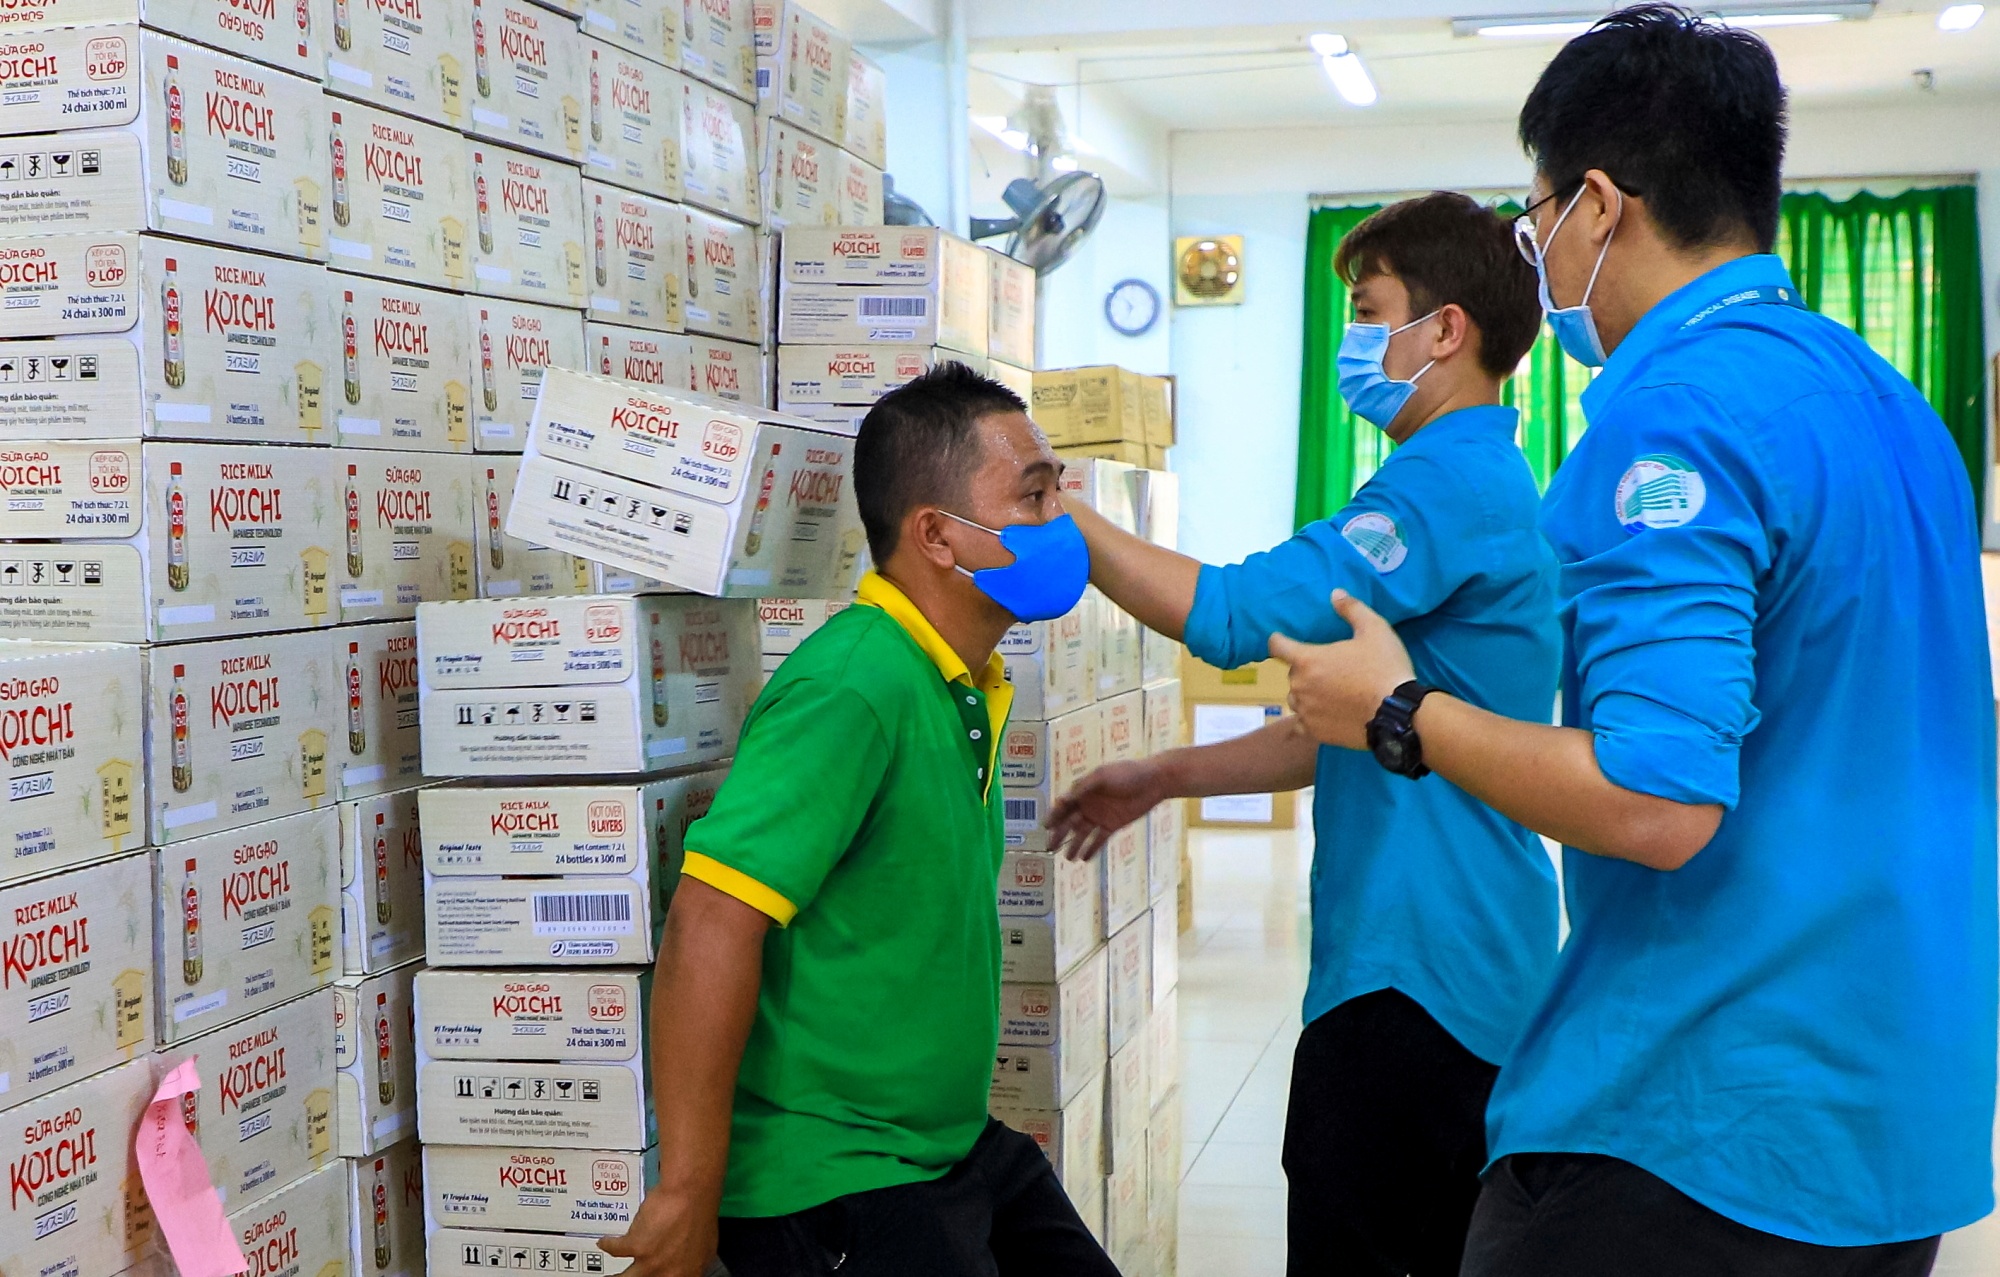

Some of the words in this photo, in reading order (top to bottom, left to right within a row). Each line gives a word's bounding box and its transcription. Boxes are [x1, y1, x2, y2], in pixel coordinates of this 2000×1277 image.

[219, 11, 241, 31] GẠO
[505, 8, 522, 25] RICE
[522, 15, 538, 31] MILK
[20, 43, 44, 54] GẠO
[107, 40, 120, 50] CAO
[500, 25, 546, 66] KOICHI
[0, 56, 57, 86] OICHI
[89, 63, 96, 75] 9
[100, 60, 124, 75] LỚP
[215, 70, 238, 92] RICE
[240, 77, 266, 98] MILK
[62, 103, 73, 113] 24
[75, 101, 91, 113] chai
[94, 103, 98, 111] x
[100, 100, 116, 111] 300
[118, 98, 127, 110] ml
[612, 77, 651, 114] KOICHI
[206, 92, 275, 141] KOICHI
[372, 124, 393, 142] RICE
[393, 131, 414, 147] MILK
[364, 142, 423, 185] KOICHI
[507, 161, 524, 176] RICE
[525, 166, 541, 180] MILK
[502, 178, 549, 215] KOICHI
[616, 217, 654, 250] KOICHI
[0, 248, 20, 258] SỮA
[21, 248, 45, 259] GẠO
[704, 237, 736, 267] KOICHI
[833, 242, 880, 256] KOICHI
[907, 247, 926, 256] LAYERS
[0, 262, 58, 288] OICHI
[88, 271, 96, 282] 9
[100, 267, 124, 282] LỚP
[215, 266, 239, 283] RICE
[241, 271, 266, 287] MILK
[205, 288, 275, 334] KOICHI
[382, 298, 400, 313] RICE
[401, 300, 421, 316] MILK
[527, 317, 542, 331] GẠO
[374, 317, 428, 357] KOICHI
[506, 334, 551, 369] KOICHI
[624, 357, 664, 385] KOICHI
[705, 363, 740, 392] KOICHI
[828, 361, 875, 376] KOICHI
[628, 397, 651, 409] SỮA
[651, 402, 672, 416] GẠO
[611, 407, 679, 440] KOICHI
[1, 451, 25, 462] SỮA
[25, 451, 49, 463] GẠO
[703, 441, 712, 452] 9
[714, 439, 737, 458] LỚP
[92, 476, 100, 488] 9
[103, 473, 128, 488] LỚP
[221, 463, 246, 479] RICE
[247, 464, 273, 479] MILK
[386, 466, 403, 483] SỮA
[404, 469, 421, 485] GẠO
[788, 468, 843, 507] KOICHI
[66, 514, 77, 524] 24
[78, 513, 94, 524] chai
[101, 513, 117, 523] 300
[119, 513, 129, 523] ml
[210, 486, 282, 532] KOICHI
[377, 488, 431, 529] KOICHI
[525, 608, 547, 618] GẠO
[492, 621, 561, 645] KOICHI
[586, 629, 595, 640] 9
[597, 626, 620, 640] LỚP
[221, 657, 246, 675] RICE
[247, 654, 271, 671] MILK
[1, 678, 28, 701] SỮA
[30, 676, 59, 698] GẠO
[211, 677, 280, 729] KOICHI
[13, 755, 28, 768] CÔNG
[29, 752, 45, 769] NGHỆ
[12, 777, 52, 796] ライスミルク
[501, 801, 524, 810] RICE
[526, 801, 550, 809] MILK
[591, 807, 604, 818] NOT
[605, 807, 622, 818] OVER
[491, 812, 559, 836] KOICHI
[591, 821, 596, 833] 9
[597, 820, 623, 833] LAYERS
[234, 844, 255, 865] SỮA
[256, 840, 278, 860] GẠO
[439, 843, 466, 853] Original
[467, 844, 482, 852] Taste
[555, 855, 566, 864] 24
[566, 854, 593, 864] bottles
[600, 854, 615, 864] 300
[616, 854, 626, 863] ml
[1018, 874, 1023, 882] 9
[1026, 873, 1042, 882] LỚP
[222, 860, 290, 920] KOICHI
[15, 900, 45, 926] RICE
[46, 892, 79, 917] MILK
[3, 917, 90, 990] KOICHI
[31, 969, 57, 989] JAPANESE
[58, 961, 90, 983] TECHNOLOGY
[505, 984, 525, 993] SỮA
[527, 984, 550, 993] GẠO
[30, 994, 69, 1018] ライスミルク
[493, 995, 562, 1017] KOICHI
[590, 1007, 598, 1016] 9
[601, 1005, 624, 1016] LỚP
[1031, 1005, 1048, 1013] LỚP
[229, 1037, 253, 1060] RICE
[254, 1027, 278, 1050] MILK
[566, 1039, 577, 1047] 24
[578, 1039, 592, 1047] chai
[600, 1038, 614, 1047] 300
[616, 1038, 626, 1047] ml
[219, 1047, 286, 1115] KOICHI
[25, 1117, 52, 1145] SỮA
[54, 1107, 82, 1134] GẠO
[10, 1128, 97, 1211] KOICHI
[511, 1156, 532, 1165] SỮA
[532, 1156, 555, 1165] GẠO
[500, 1166, 567, 1188] KOICHI
[595, 1181, 601, 1191] 9
[603, 1178, 627, 1191] LỚP
[36, 1208, 76, 1235] ライスミルク
[244, 1223, 264, 1245] SỮA
[265, 1211, 286, 1233] GẠO
